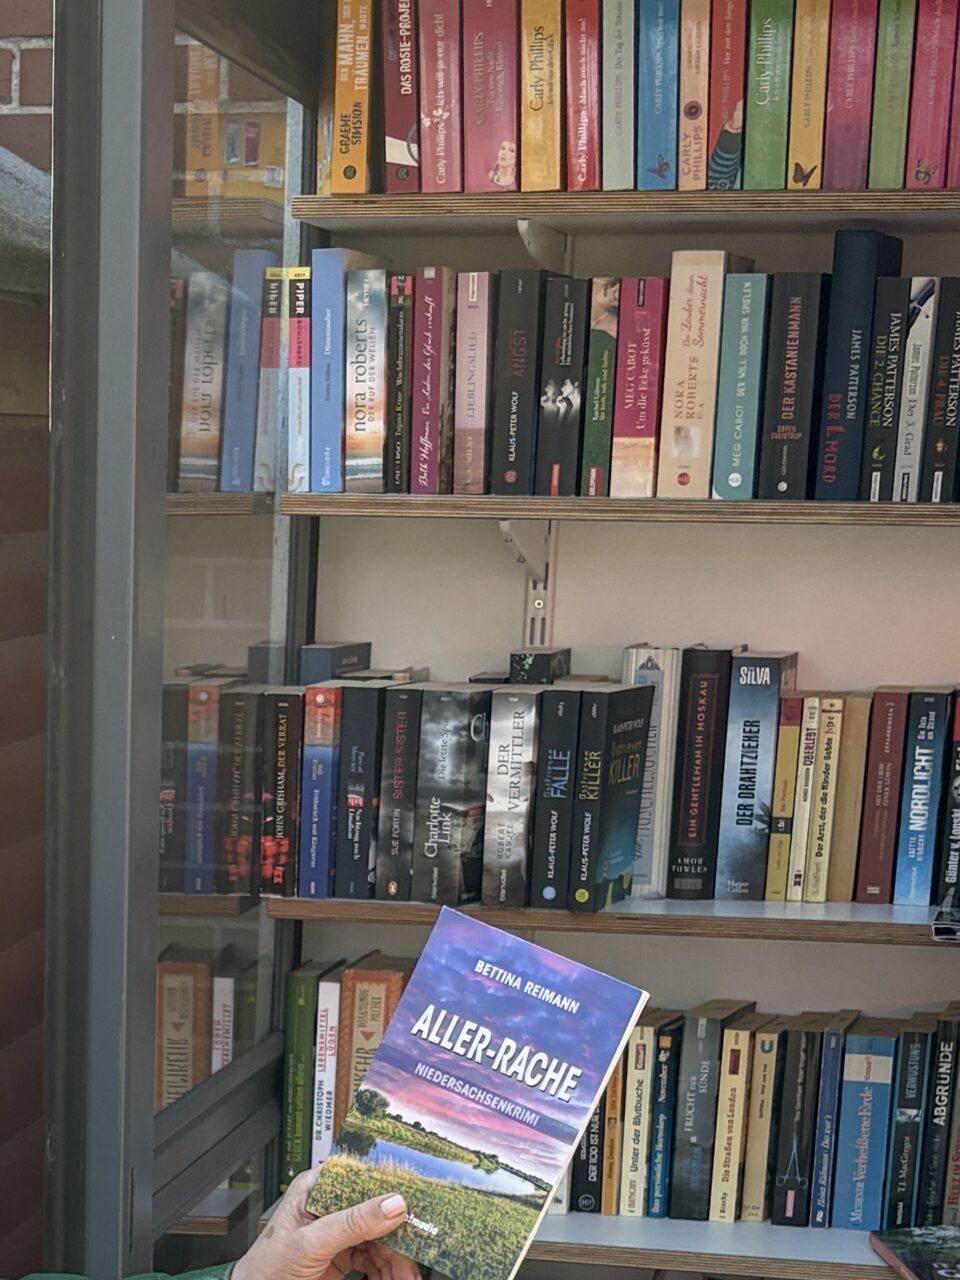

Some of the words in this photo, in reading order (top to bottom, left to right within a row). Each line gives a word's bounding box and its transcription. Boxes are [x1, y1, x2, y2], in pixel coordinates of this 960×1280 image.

[338, 21, 355, 65] MANN,
[398, 0, 411, 72] ROSIE-PROJE
[530, 26, 547, 71] Phillips
[755, 18, 775, 66] Phillips
[353, 36, 368, 90] TRÄUMEN
[474, 32, 485, 81] PHILLIPS
[401, 74, 412, 94] DAS
[530, 76, 547, 111] Carly
[755, 70, 772, 105] Carly
[340, 114, 351, 154] GRAEME
[352, 102, 362, 145] SIMSION
[435, 123, 447, 156] Phillips
[578, 111, 588, 150] Phillips
[435, 159, 447, 183] Carly
[578, 155, 588, 181] Carly
[682, 132, 691, 176] CARLY
[693, 125, 703, 181] PHILLIPS
[294, 282, 304, 314] PIPER
[741, 282, 752, 314] SPIELEN
[368, 327, 376, 362] WELLEN
[640, 328, 652, 365] geküsst
[783, 296, 802, 394] KASTANIENMANN
[851, 329, 862, 361] JAMES
[874, 335, 887, 353] DIE
[887, 313, 902, 352] JAMES
[351, 319, 367, 384] roberts
[513, 328, 527, 377] ANGST
[626, 341, 638, 380] CABOT
[737, 360, 746, 377] WILL
[467, 331, 477, 418] LIEBLINGSLIED
[638, 368, 649, 390] Ecke
[686, 356, 697, 419] ROBERTS
[736, 382, 745, 396] DER
[846, 364, 860, 419] PATTERSON
[882, 355, 897, 426] PATTERSON
[353, 393, 366, 432] nora
[624, 383, 635, 409] MEG
[637, 393, 647, 406] die
[674, 381, 685, 419] NORA
[782, 397, 796, 419] DER
[829, 392, 842, 419] DER
[870, 372, 883, 426] CHANCE
[508, 414, 518, 461] KLAUS-PETER
[636, 411, 646, 430] Um
[733, 404, 743, 439] CABOT
[732, 443, 741, 467] MEG
[822, 440, 837, 483] MORD
[903, 433, 914, 456] Grad
[697, 680, 708, 730] MOSKAU
[278, 714, 287, 747] VERRAT
[395, 711, 407, 753] SISTER
[696, 736, 704, 747] IN
[278, 750, 286, 767] DER
[437, 765, 447, 780] Die
[497, 744, 510, 775] DER
[508, 710, 526, 811] VERMITTLER
[551, 750, 570, 798] FALLE
[587, 751, 601, 800] KILLER
[608, 754, 640, 785] KILLER
[739, 720, 760, 799] DRAHTZIEHER
[820, 763, 831, 791] Kinder
[393, 758, 404, 800] SISTER
[690, 750, 702, 816] GENTLEMAN
[909, 745, 934, 831] NORDLICHT
[735, 804, 753, 826] DER
[819, 793, 828, 805] die
[819, 807, 827, 820] der
[275, 815, 284, 838] JOHN
[425, 797, 441, 857] Charlotte
[440, 813, 452, 844] Link
[550, 809, 558, 831] WOLF
[583, 812, 591, 834] WOLF
[391, 840, 399, 855] SUE
[547, 832, 557, 878] KLAUS-PETER
[580, 835, 590, 881] KLAUS-PETER
[815, 843, 823, 857] Der
[944, 851, 959, 883] Günter
[474, 960, 522, 990] BETTINA
[524, 980, 580, 1015] REIMANN
[317, 1008, 328, 1072] LEBENSMITTEL
[326, 1026, 336, 1056] LÜGEN
[411, 1003, 582, 1104] ALLER-RACHE
[658, 1064, 668, 1103] November
[698, 1060, 710, 1094] SÜNDE
[904, 1043, 921, 1099] VERWÜSTUNG
[933, 1041, 953, 1126] ABGRÜNDE
[316, 1080, 324, 1127] CHRISTOPH
[325, 1091, 333, 1131] WIEDMER
[414, 1062, 540, 1127] NIEDERSACHSENKRIMI
[633, 1079, 643, 1126] Blutbuche
[684, 1092, 696, 1132] FRUCHT
[727, 1087, 737, 1119] London
[859, 1086, 873, 1116] Erde
[589, 1133, 599, 1145] IST
[589, 1147, 599, 1162] TOD
[631, 1129, 641, 1144] der
[723, 1136, 734, 1168] Straßen
[853, 1117, 871, 1181] Verheißene
[588, 1165, 598, 1182] DER
[630, 1148, 639, 1173] Unter
[899, 1136, 910, 1178] MacGregor
[722, 1169, 730, 1183] Die
